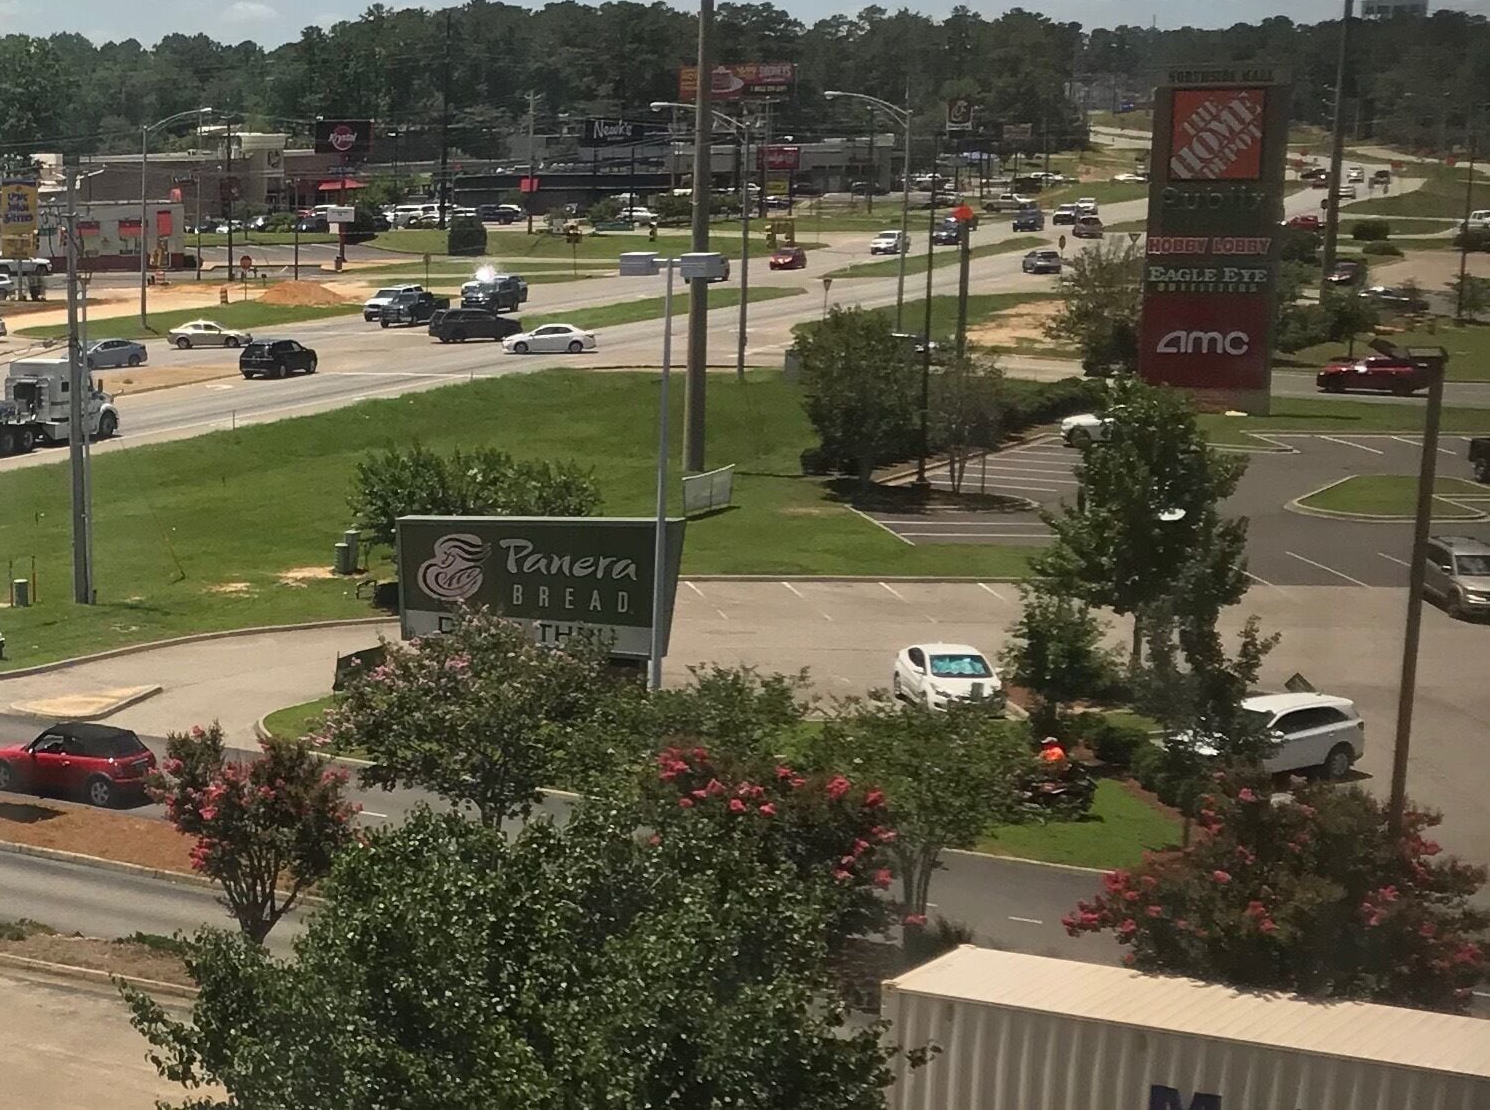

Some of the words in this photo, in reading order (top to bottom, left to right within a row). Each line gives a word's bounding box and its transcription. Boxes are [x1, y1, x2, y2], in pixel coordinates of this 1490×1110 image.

[1147, 237, 1208, 254] HOBBY
[1212, 237, 1271, 254] LOBBY
[1149, 267, 1217, 282] EAGLE
[1222, 267, 1268, 282] EYE
[499, 538, 637, 581] Panera
[513, 584, 629, 613] BREAD
